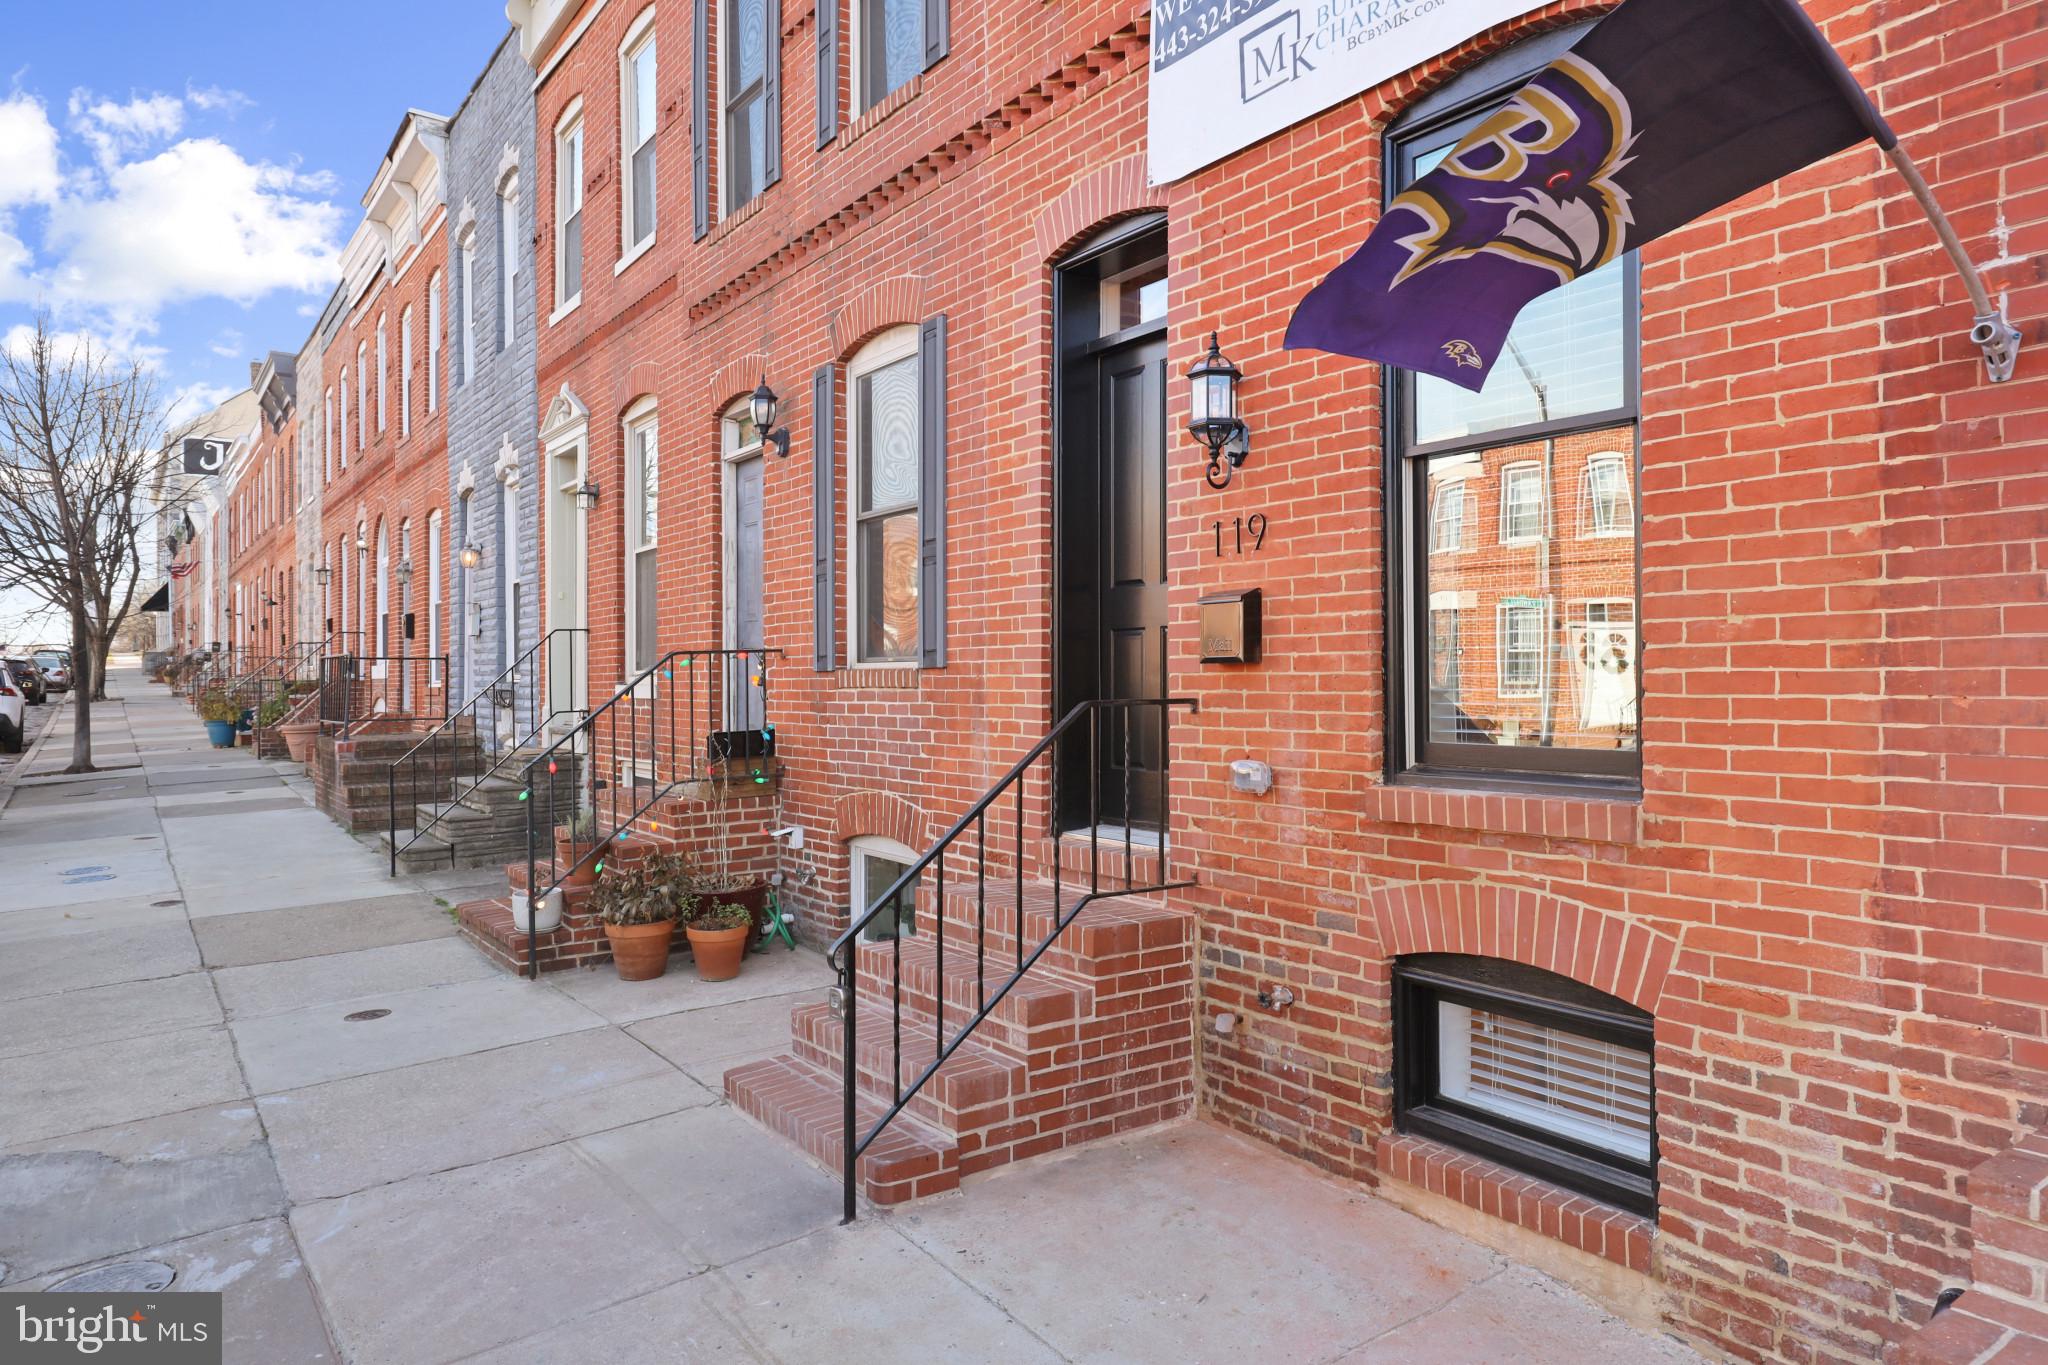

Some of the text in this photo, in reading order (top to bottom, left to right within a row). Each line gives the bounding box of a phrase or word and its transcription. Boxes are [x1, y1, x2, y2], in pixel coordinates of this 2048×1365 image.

[1155, 0, 1261, 64] 443-324-
[1156, 0, 1192, 28] WE
[1315, 0, 1414, 50] CHARA
[200, 441, 224, 471] J
[1212, 512, 1268, 558] 119
